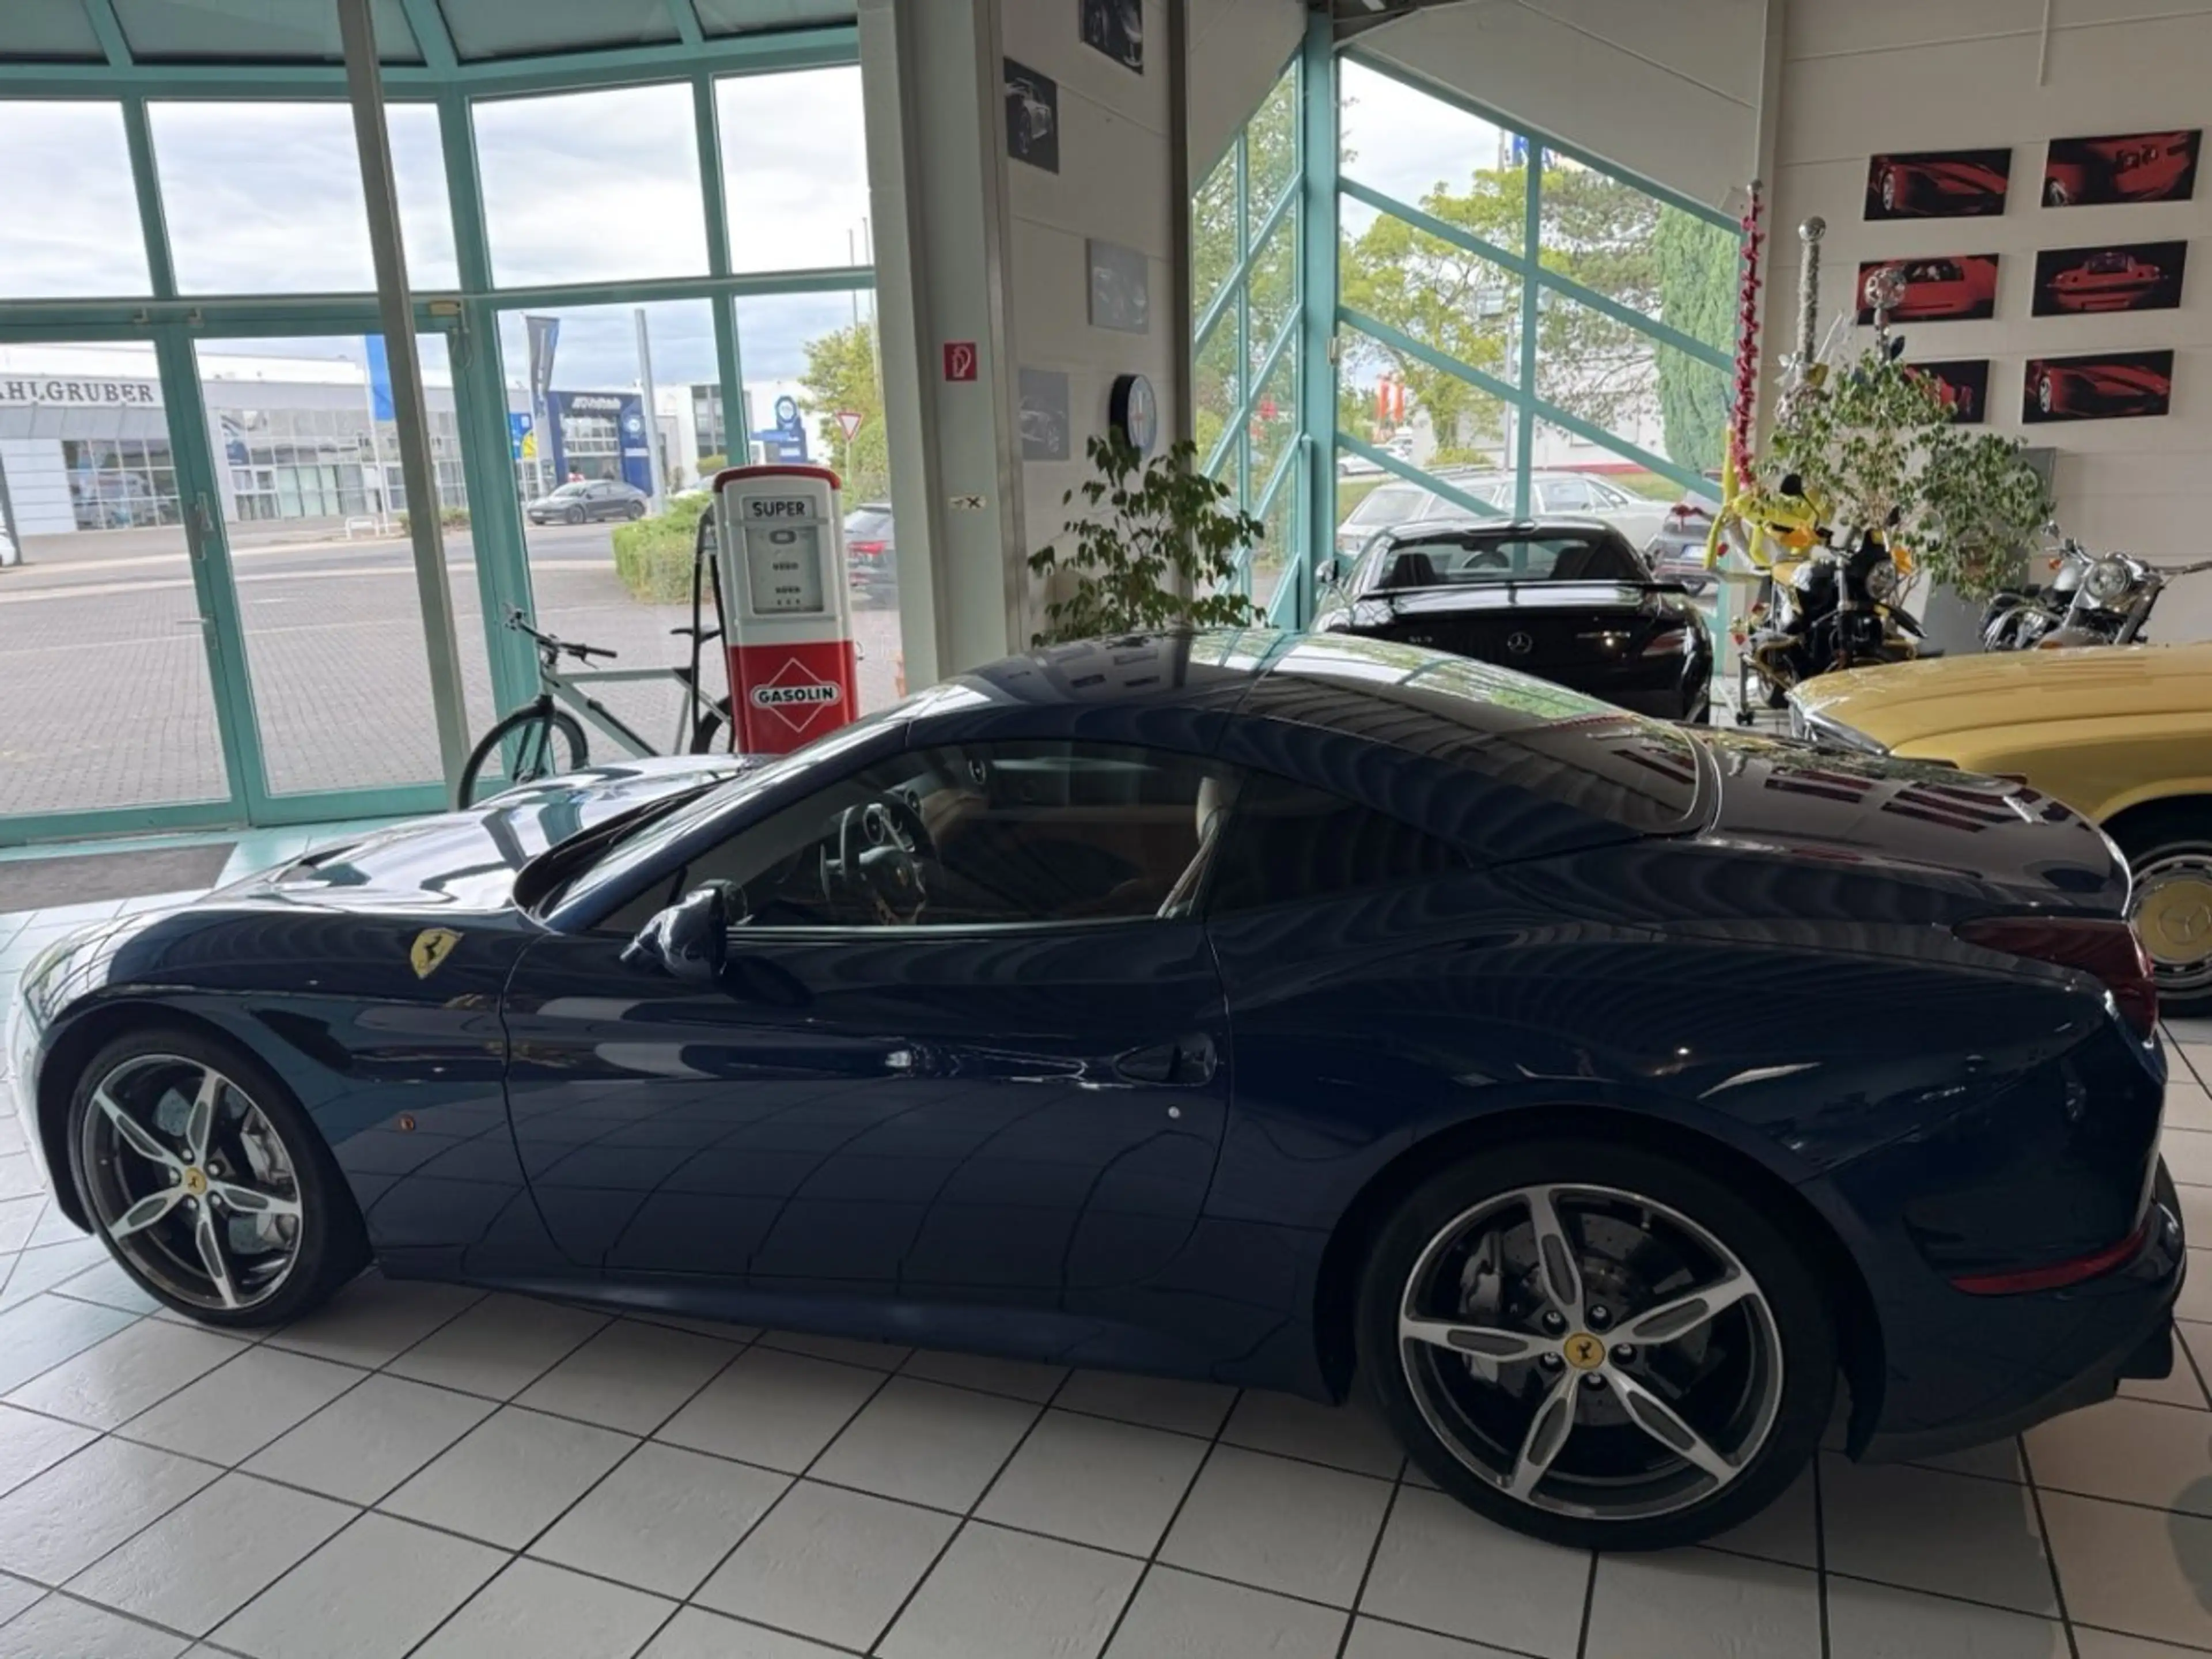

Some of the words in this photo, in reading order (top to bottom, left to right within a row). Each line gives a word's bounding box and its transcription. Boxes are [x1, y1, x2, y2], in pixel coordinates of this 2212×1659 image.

[0, 381, 154, 402] HLGRUBER
[752, 501, 805, 518] SUPER
[759, 687, 834, 703] GASOLIN
